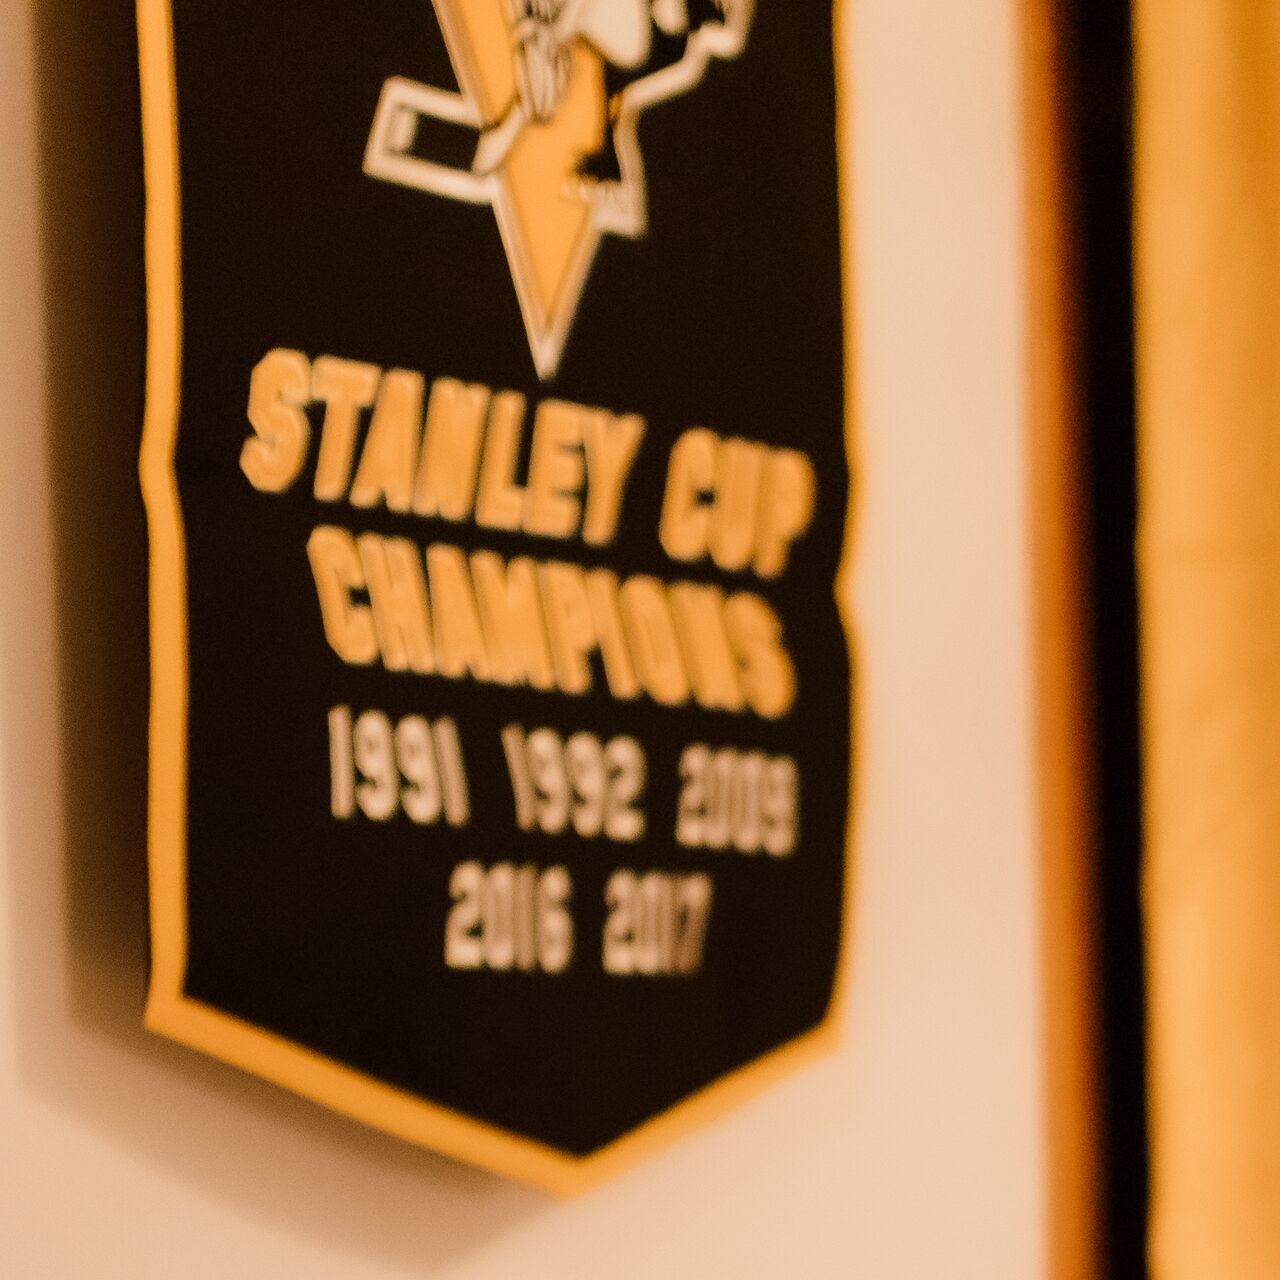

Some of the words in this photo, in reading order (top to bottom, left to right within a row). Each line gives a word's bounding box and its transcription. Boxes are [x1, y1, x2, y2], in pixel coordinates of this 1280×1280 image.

[240, 348, 645, 545] STANLEY
[659, 428, 816, 579] CUP
[306, 525, 796, 720] CHAMPIONS
[328, 706, 468, 825] 1991
[502, 726, 646, 840] 1992
[676, 745, 797, 856] 2009
[445, 861, 573, 973] 2016
[602, 870, 711, 975] 2017
